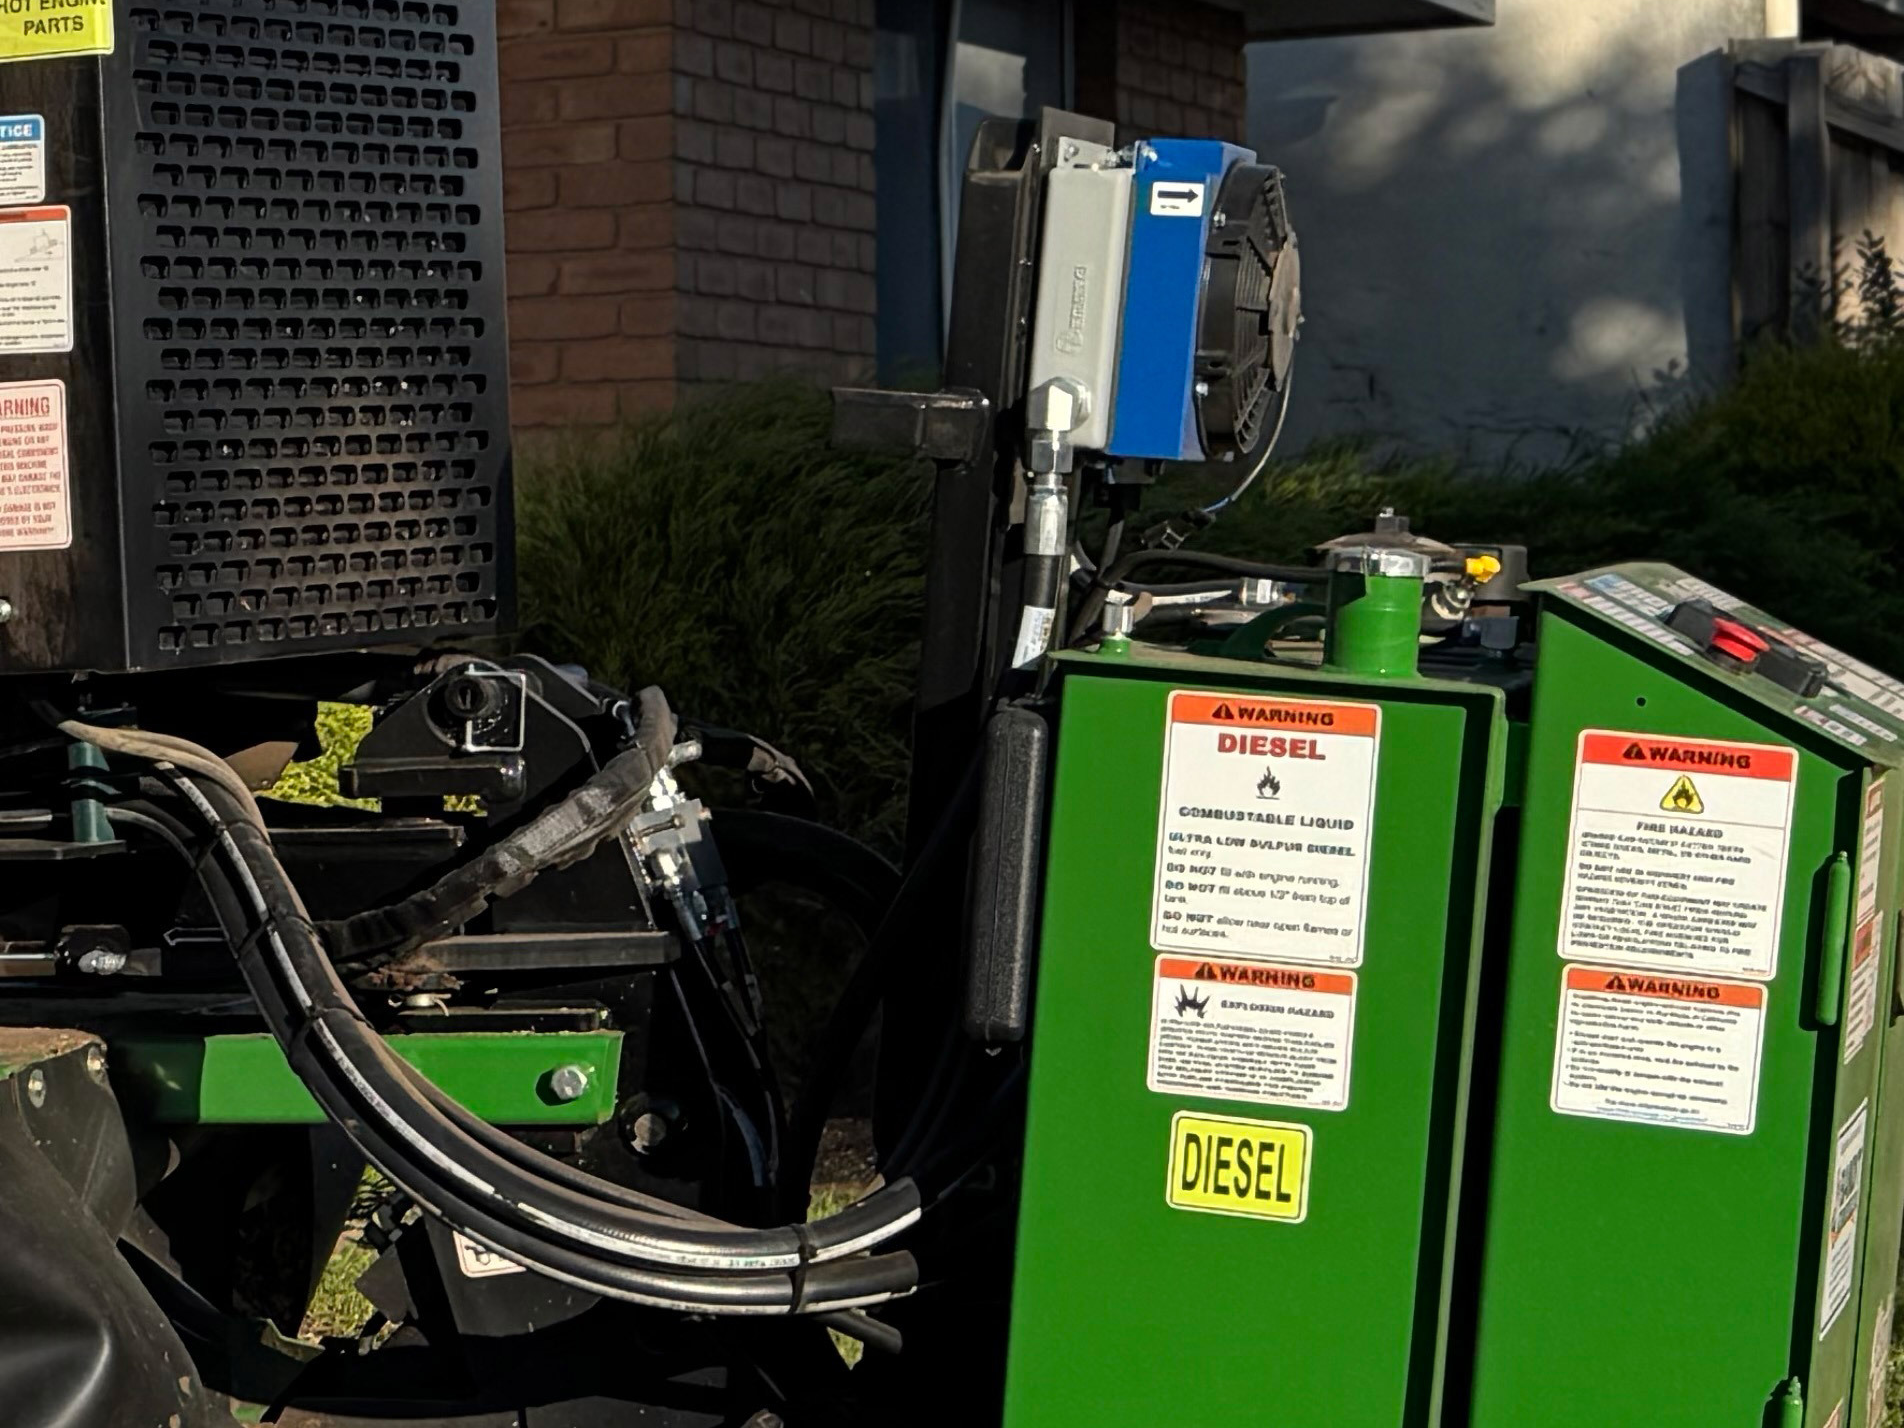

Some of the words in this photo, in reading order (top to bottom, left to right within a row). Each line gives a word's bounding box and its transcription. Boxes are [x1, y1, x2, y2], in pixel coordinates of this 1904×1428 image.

[24, 15, 84, 36] PARTS
[1238, 706, 1334, 726] WARNING
[1217, 733, 1326, 760] DIESEL
[1649, 747, 1751, 769] WARNING
[1300, 815, 1354, 830] LIQUID
[1636, 821, 1666, 834] FIRE
[1669, 824, 1723, 839] HAZARD
[1169, 832, 1212, 845] ULTRA
[1216, 836, 1245, 847] LOW
[1307, 844, 1356, 856] DIESEL
[1221, 965, 1315, 989] WARNING
[1629, 977, 1720, 1000] WARNING
[1287, 1005, 1335, 1019] HAZARD
[1181, 1133, 1291, 1203] DIESEL
